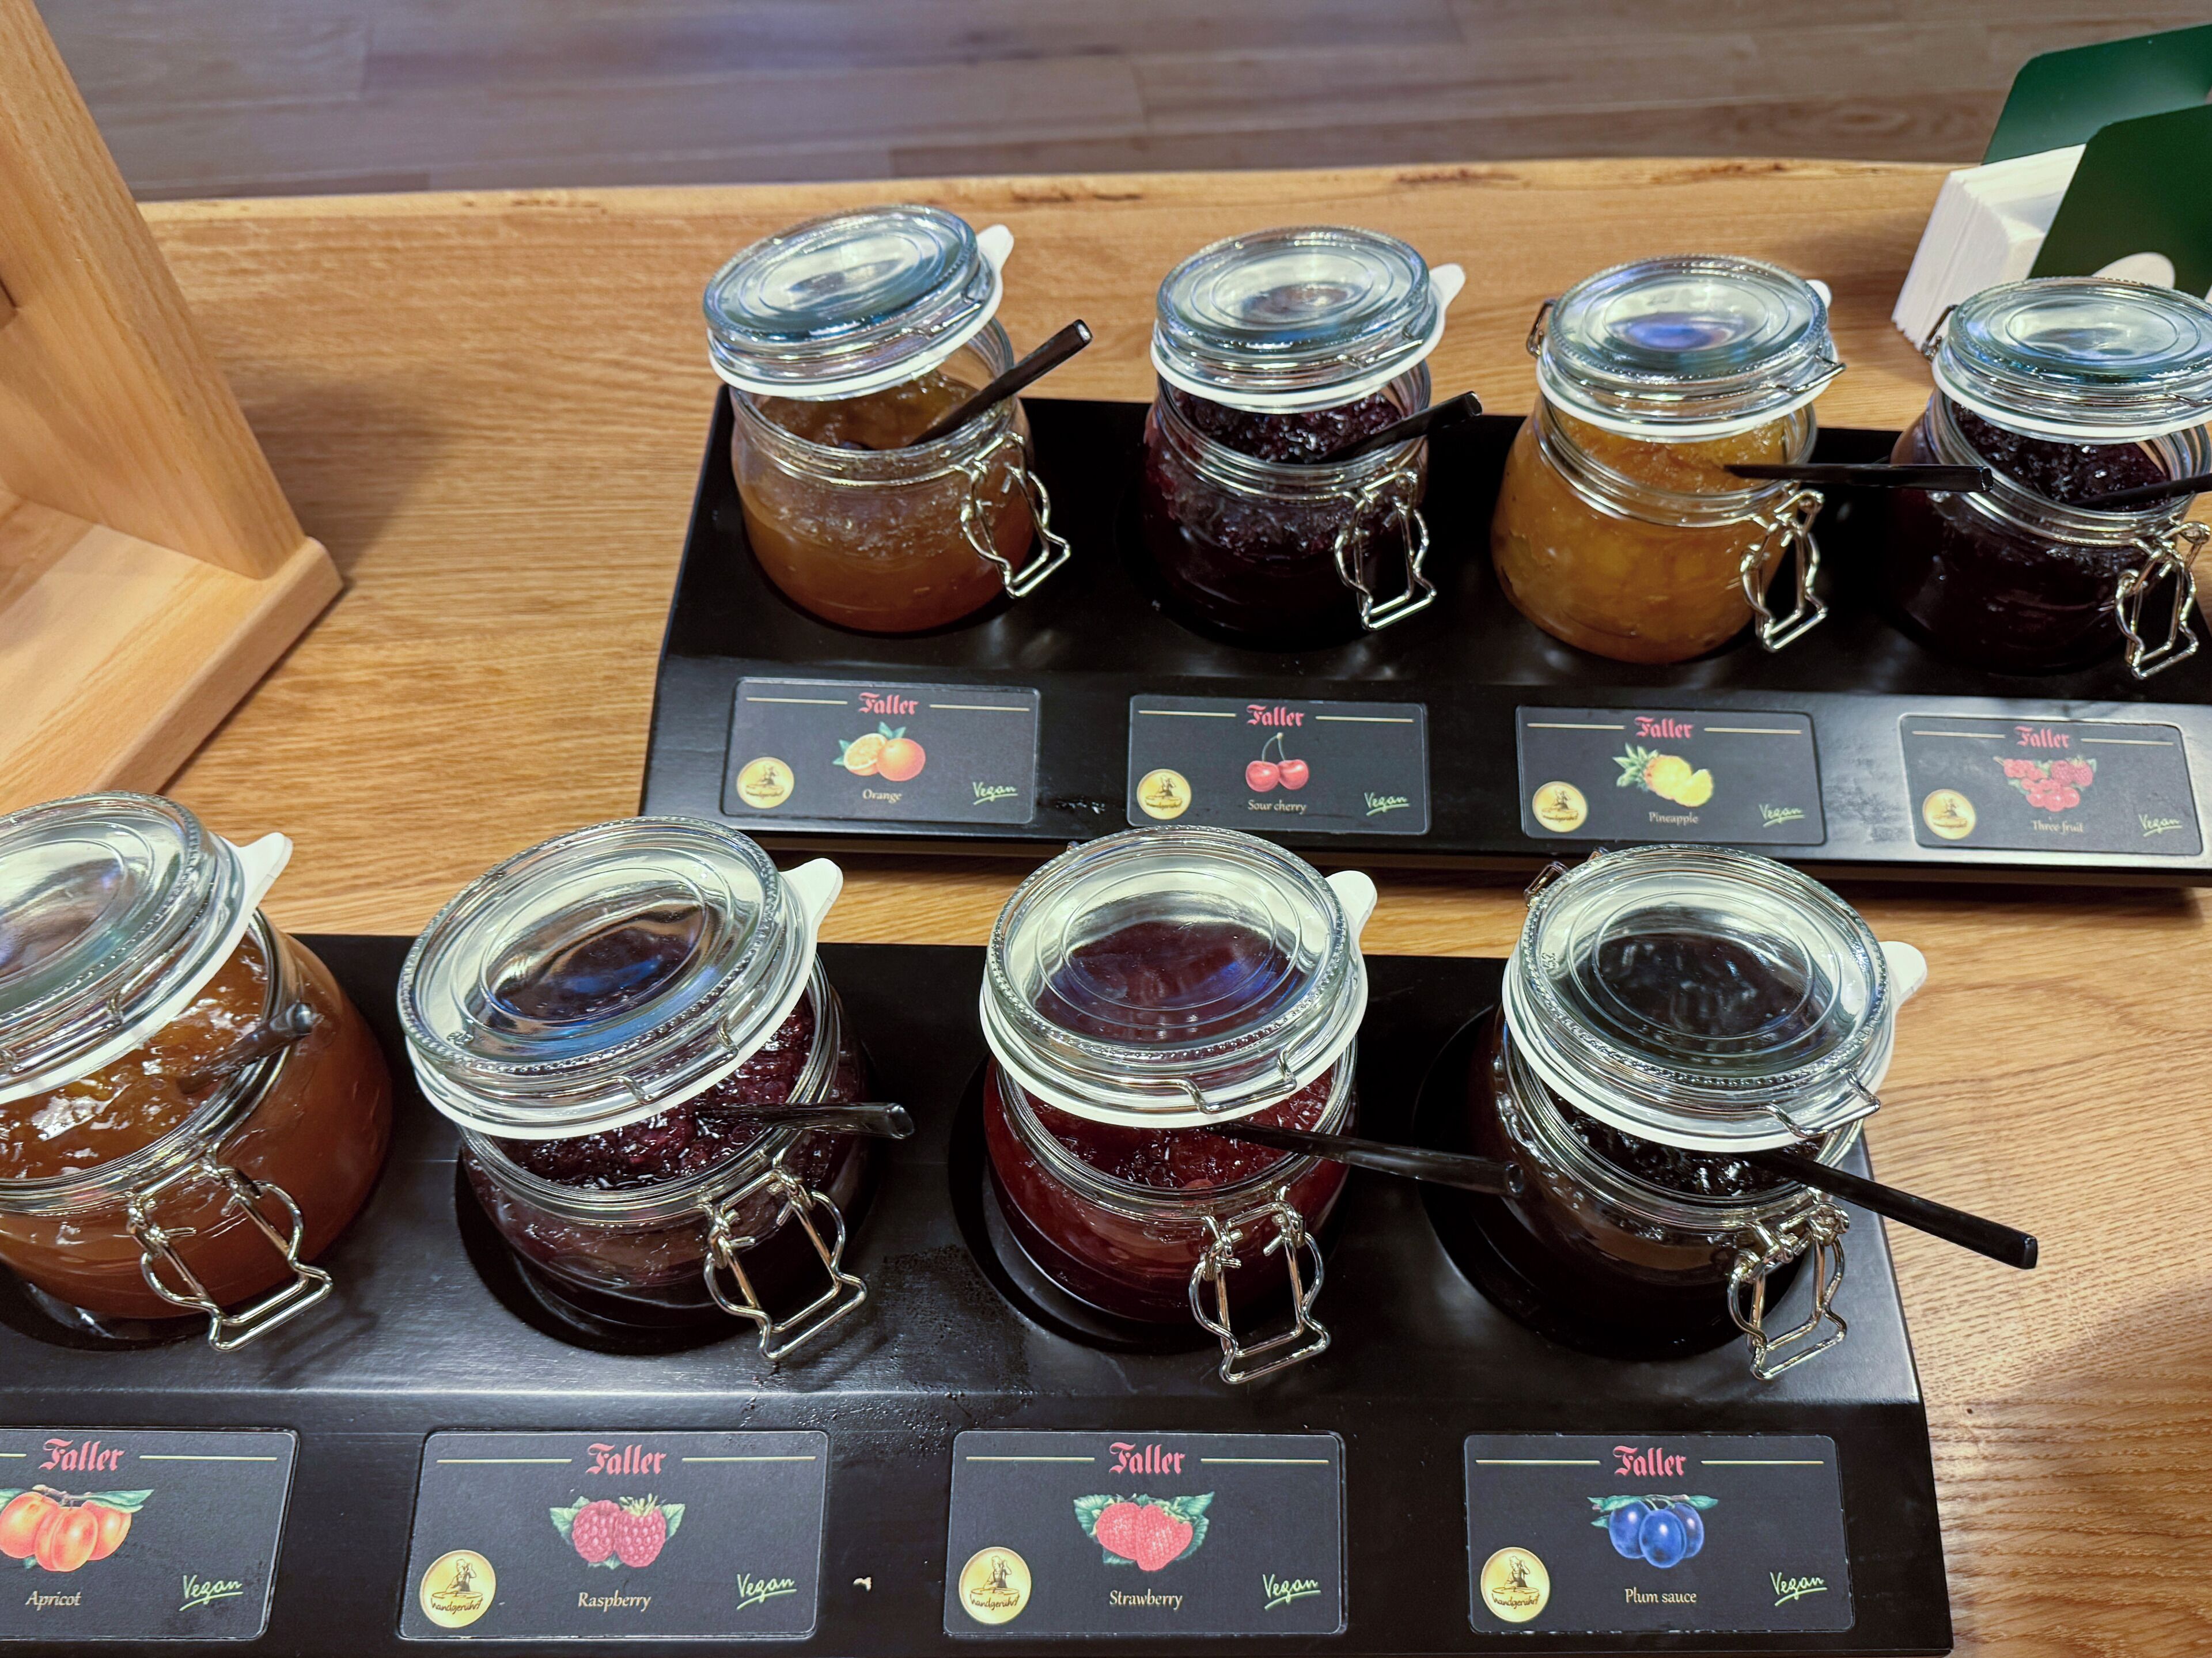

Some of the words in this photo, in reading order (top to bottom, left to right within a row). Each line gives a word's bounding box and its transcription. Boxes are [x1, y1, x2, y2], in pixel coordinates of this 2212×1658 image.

[858, 692, 920, 715] Faller
[1246, 704, 1305, 727] Faller
[1634, 716, 1694, 739] Faller
[2015, 726, 2070, 749] Faller
[862, 789, 902, 803] Orange
[972, 781, 1018, 805] Vegan
[1363, 792, 1410, 816] Vegan
[1248, 799, 1271, 811] Sour
[1273, 800, 1306, 815] cherry
[1648, 811, 1699, 826] Pineapple
[1759, 803, 1805, 827] Vegan
[2031, 819, 2059, 832] Three
[2059, 820, 2084, 836] fruit
[2138, 814, 2183, 837] Vegan
[38, 1438, 125, 1471] Faller
[585, 1443, 667, 1475] Faller
[1108, 1441, 1186, 1475] Faller
[1613, 1445, 1686, 1477] Faller
[25, 1590, 81, 1611] Apricot
[179, 1574, 244, 1612] Vegan
[737, 1573, 797, 1610] Vegan
[1109, 1589, 1183, 1611] Strawberry
[1262, 1573, 1321, 1610] Vegan
[1624, 1587, 1658, 1604] Plum
[1661, 1589, 1696, 1603] sauce
[1770, 1572, 1827, 1606] Vegan
[578, 1591, 652, 1612] Raspberry
